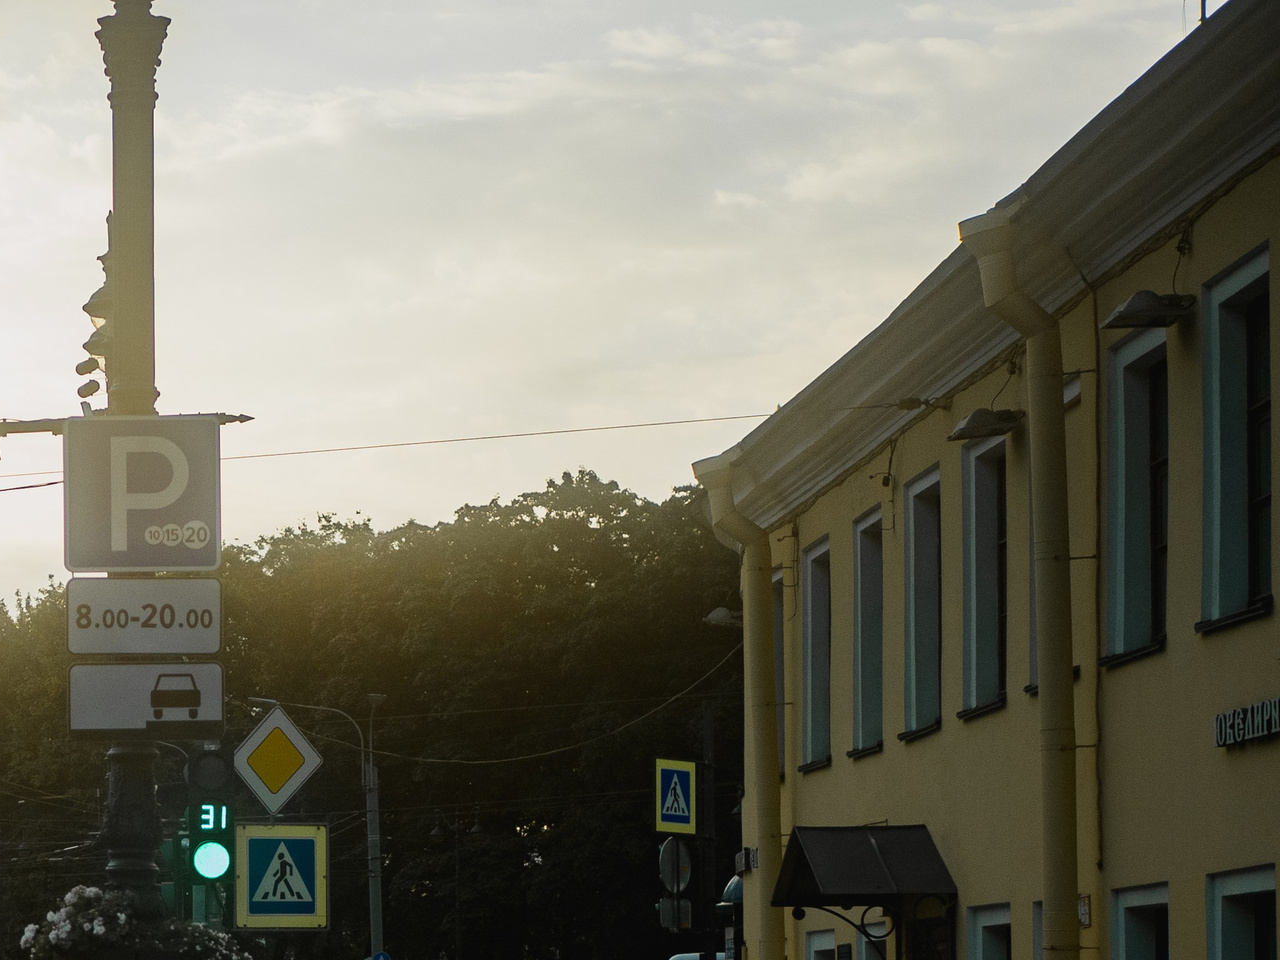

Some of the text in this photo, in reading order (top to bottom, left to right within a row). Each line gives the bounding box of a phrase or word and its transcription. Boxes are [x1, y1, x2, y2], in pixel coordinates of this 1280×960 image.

[109, 435, 190, 552] P
[148, 526, 208, 543] 10 15 20
[75, 603, 213, 630] 8.00-20.00
[200, 804, 227, 830] 31
